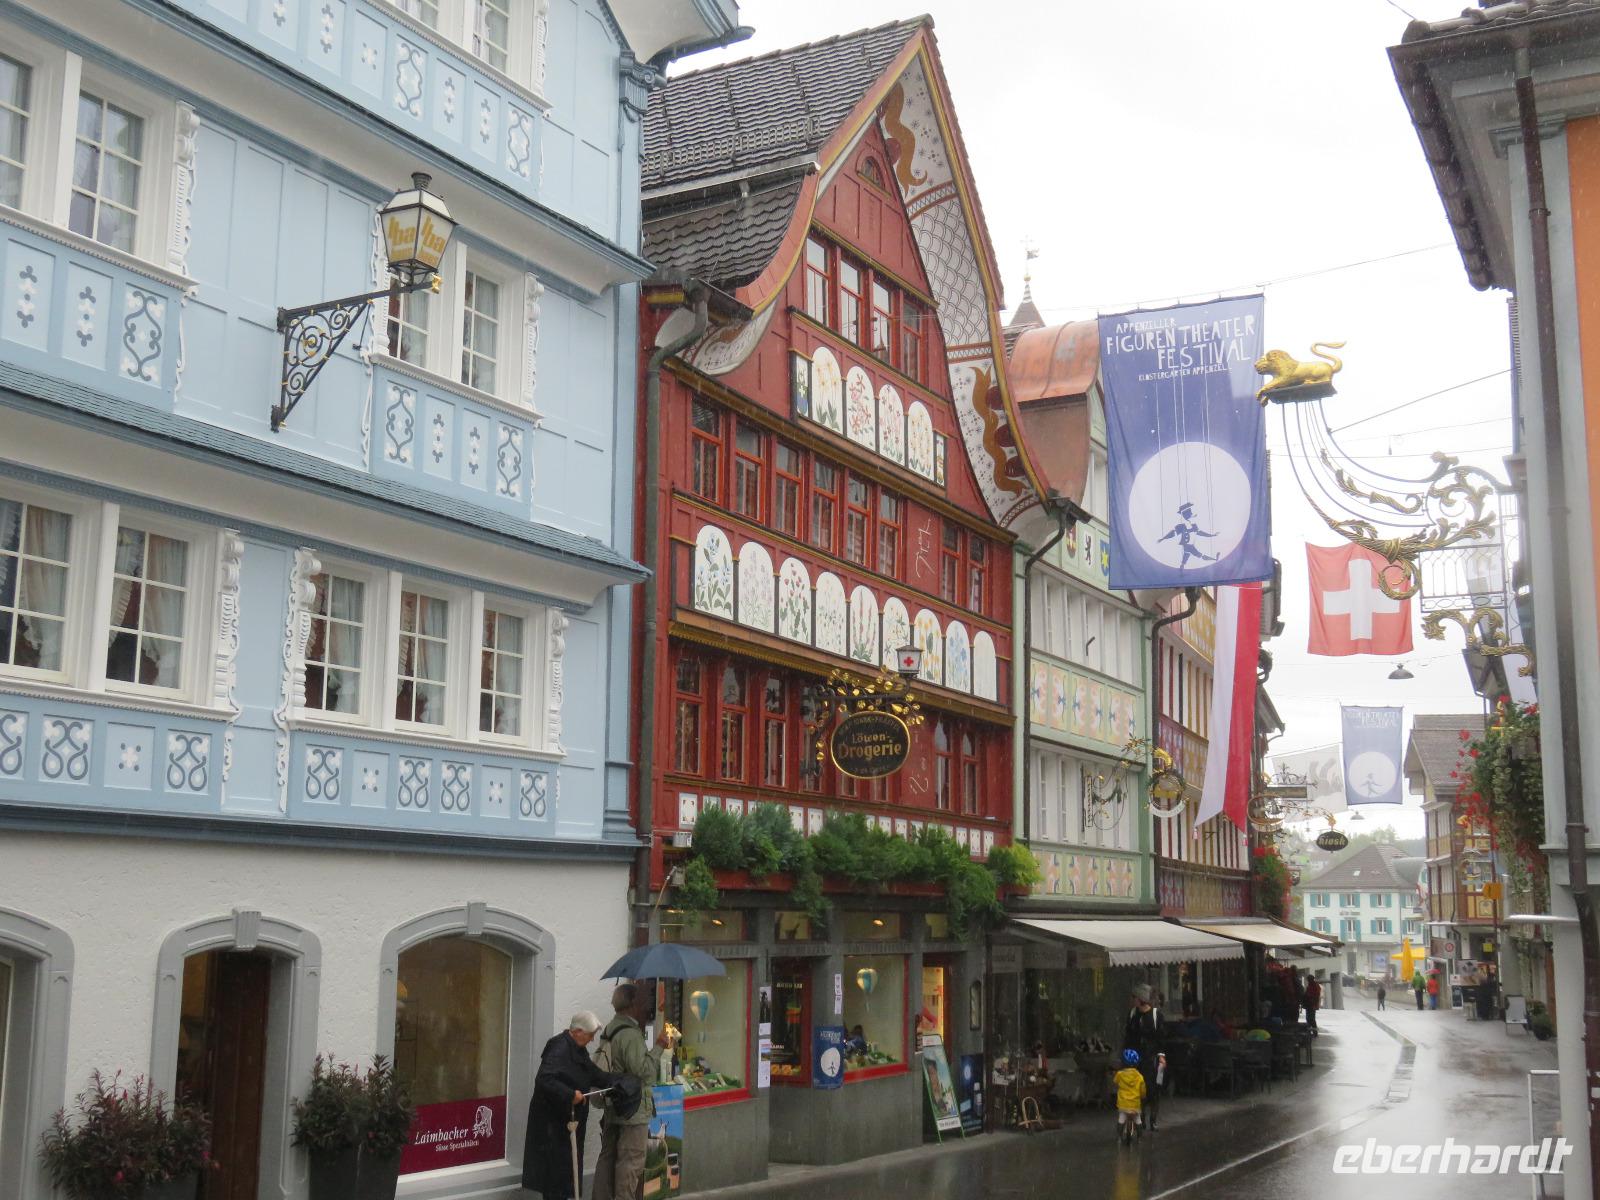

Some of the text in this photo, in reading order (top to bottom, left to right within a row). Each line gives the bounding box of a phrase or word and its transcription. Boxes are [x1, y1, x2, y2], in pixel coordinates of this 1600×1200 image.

[1115, 318, 1177, 334] APPENZELLER
[1157, 338, 1251, 370] FESTIVAL
[838, 740, 902, 760] Drogerie
[1319, 836, 1346, 847] Kiosk
[414, 1127, 469, 1145] Laimbacher
